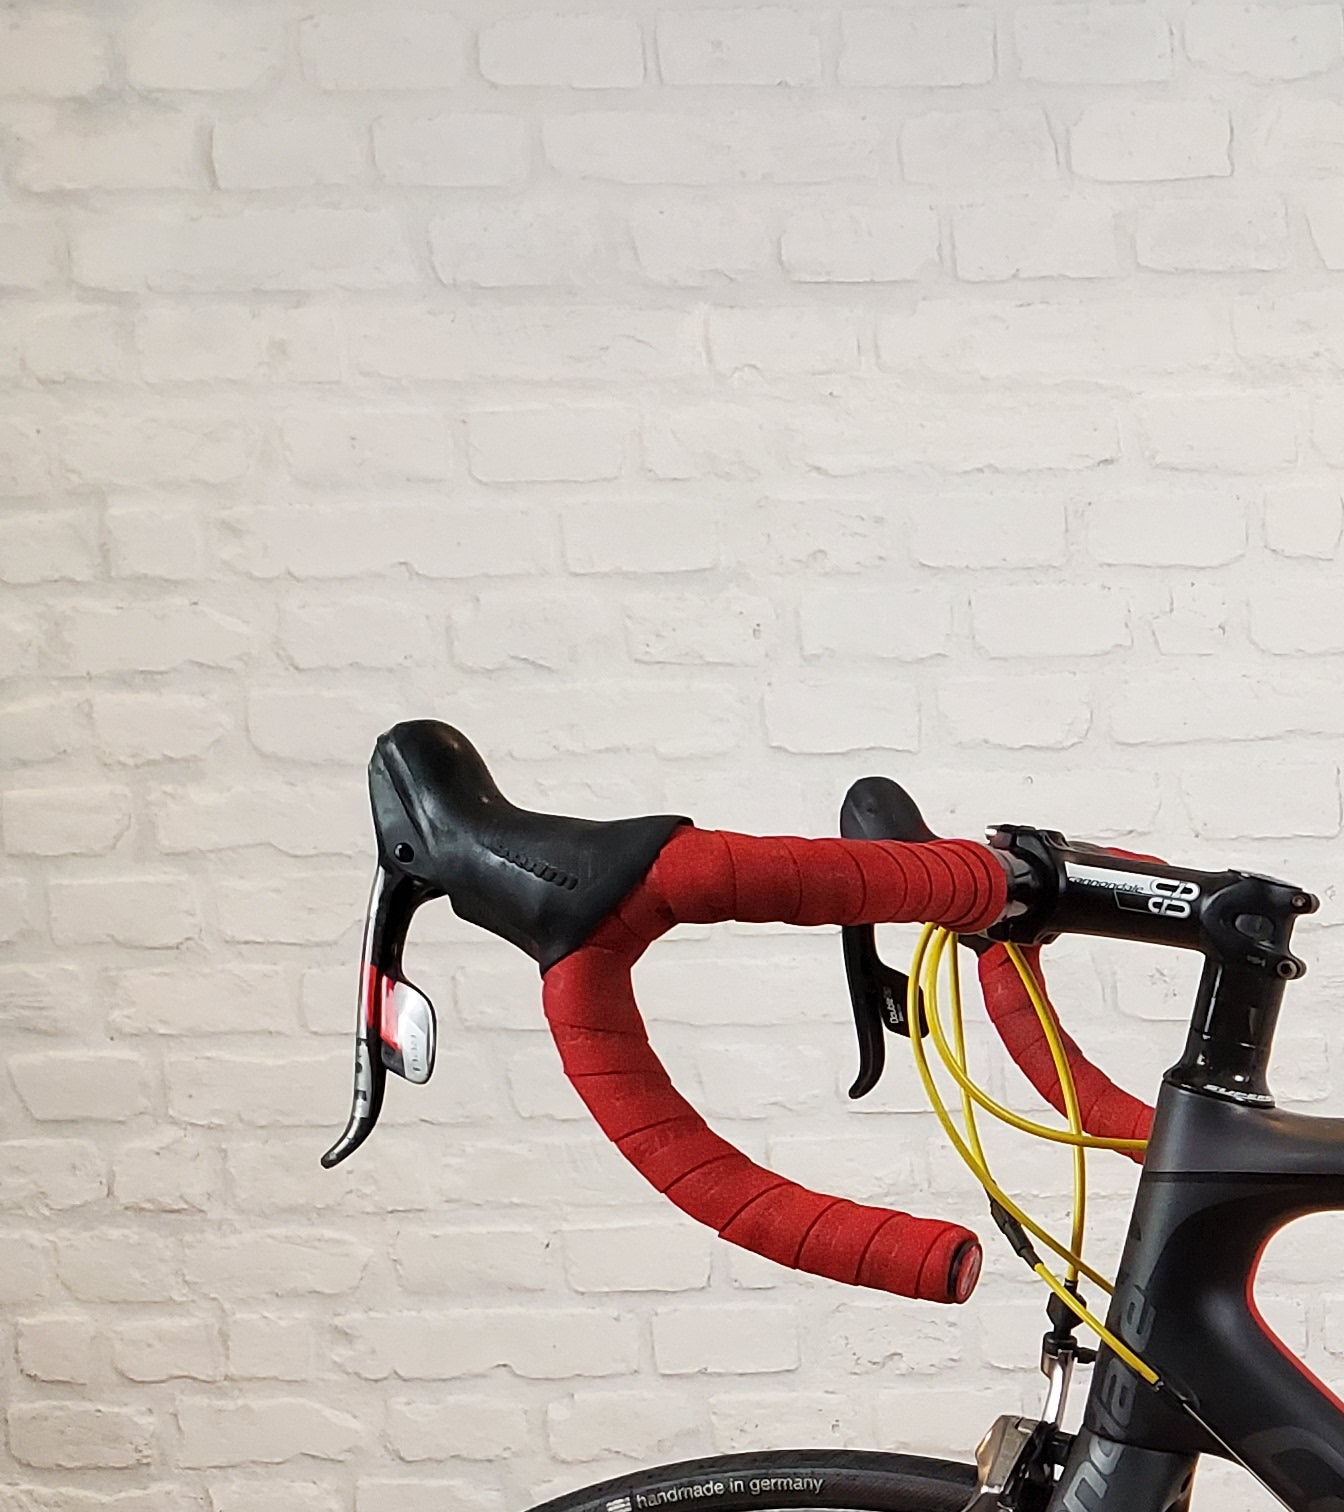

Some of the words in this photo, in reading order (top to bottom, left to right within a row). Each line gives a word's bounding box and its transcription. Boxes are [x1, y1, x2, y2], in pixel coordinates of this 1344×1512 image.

[635, 1480, 725, 1510] handmade
[728, 1477, 745, 1494] in
[749, 1476, 824, 1496] germany
